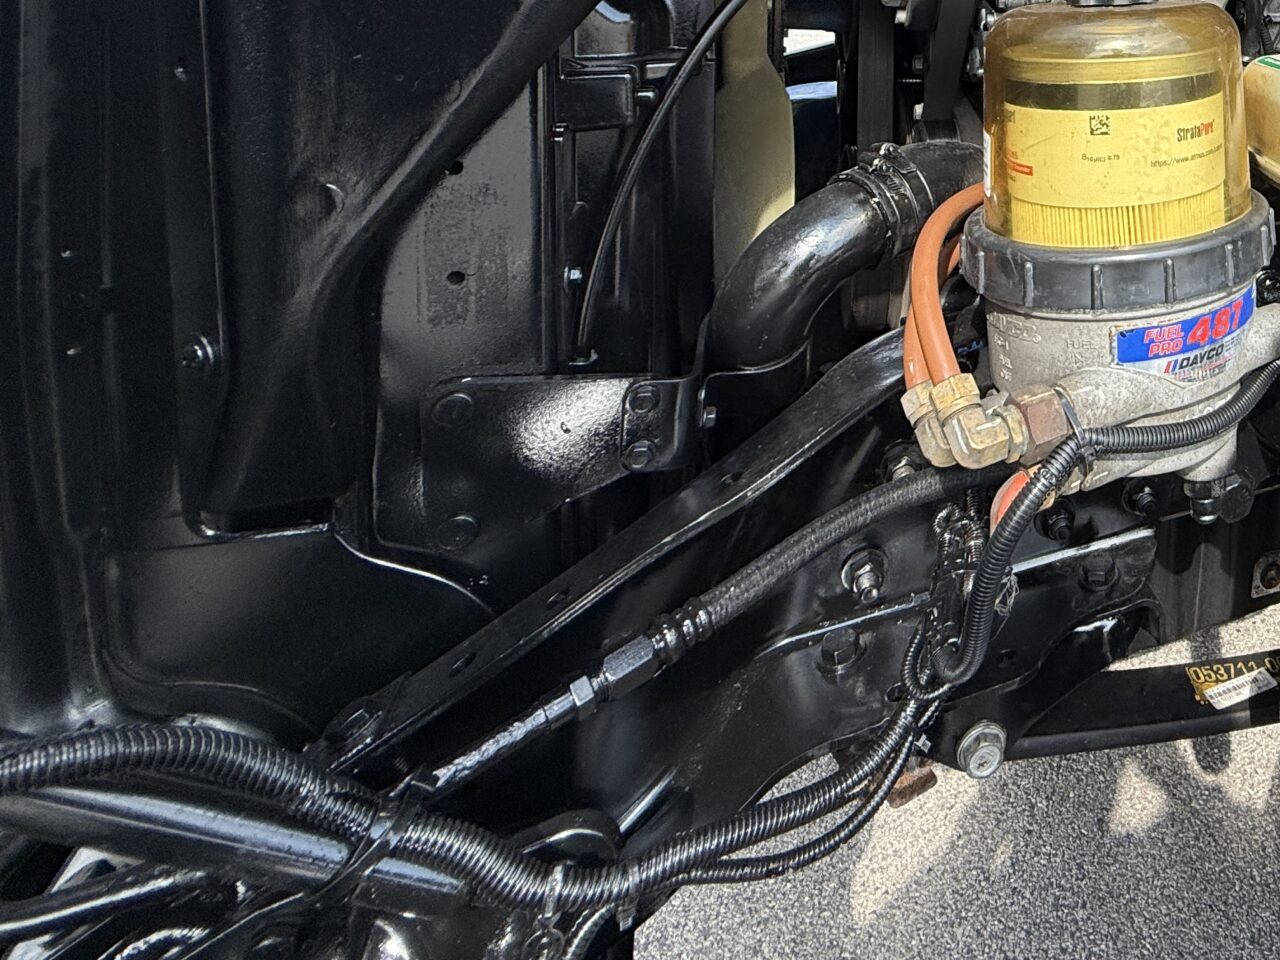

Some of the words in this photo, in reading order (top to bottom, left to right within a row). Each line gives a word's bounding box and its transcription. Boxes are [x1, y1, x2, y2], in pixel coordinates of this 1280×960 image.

[1144, 324, 1184, 344] FUEL
[1148, 339, 1184, 357] PRO
[1178, 343, 1224, 370] DAVCO
